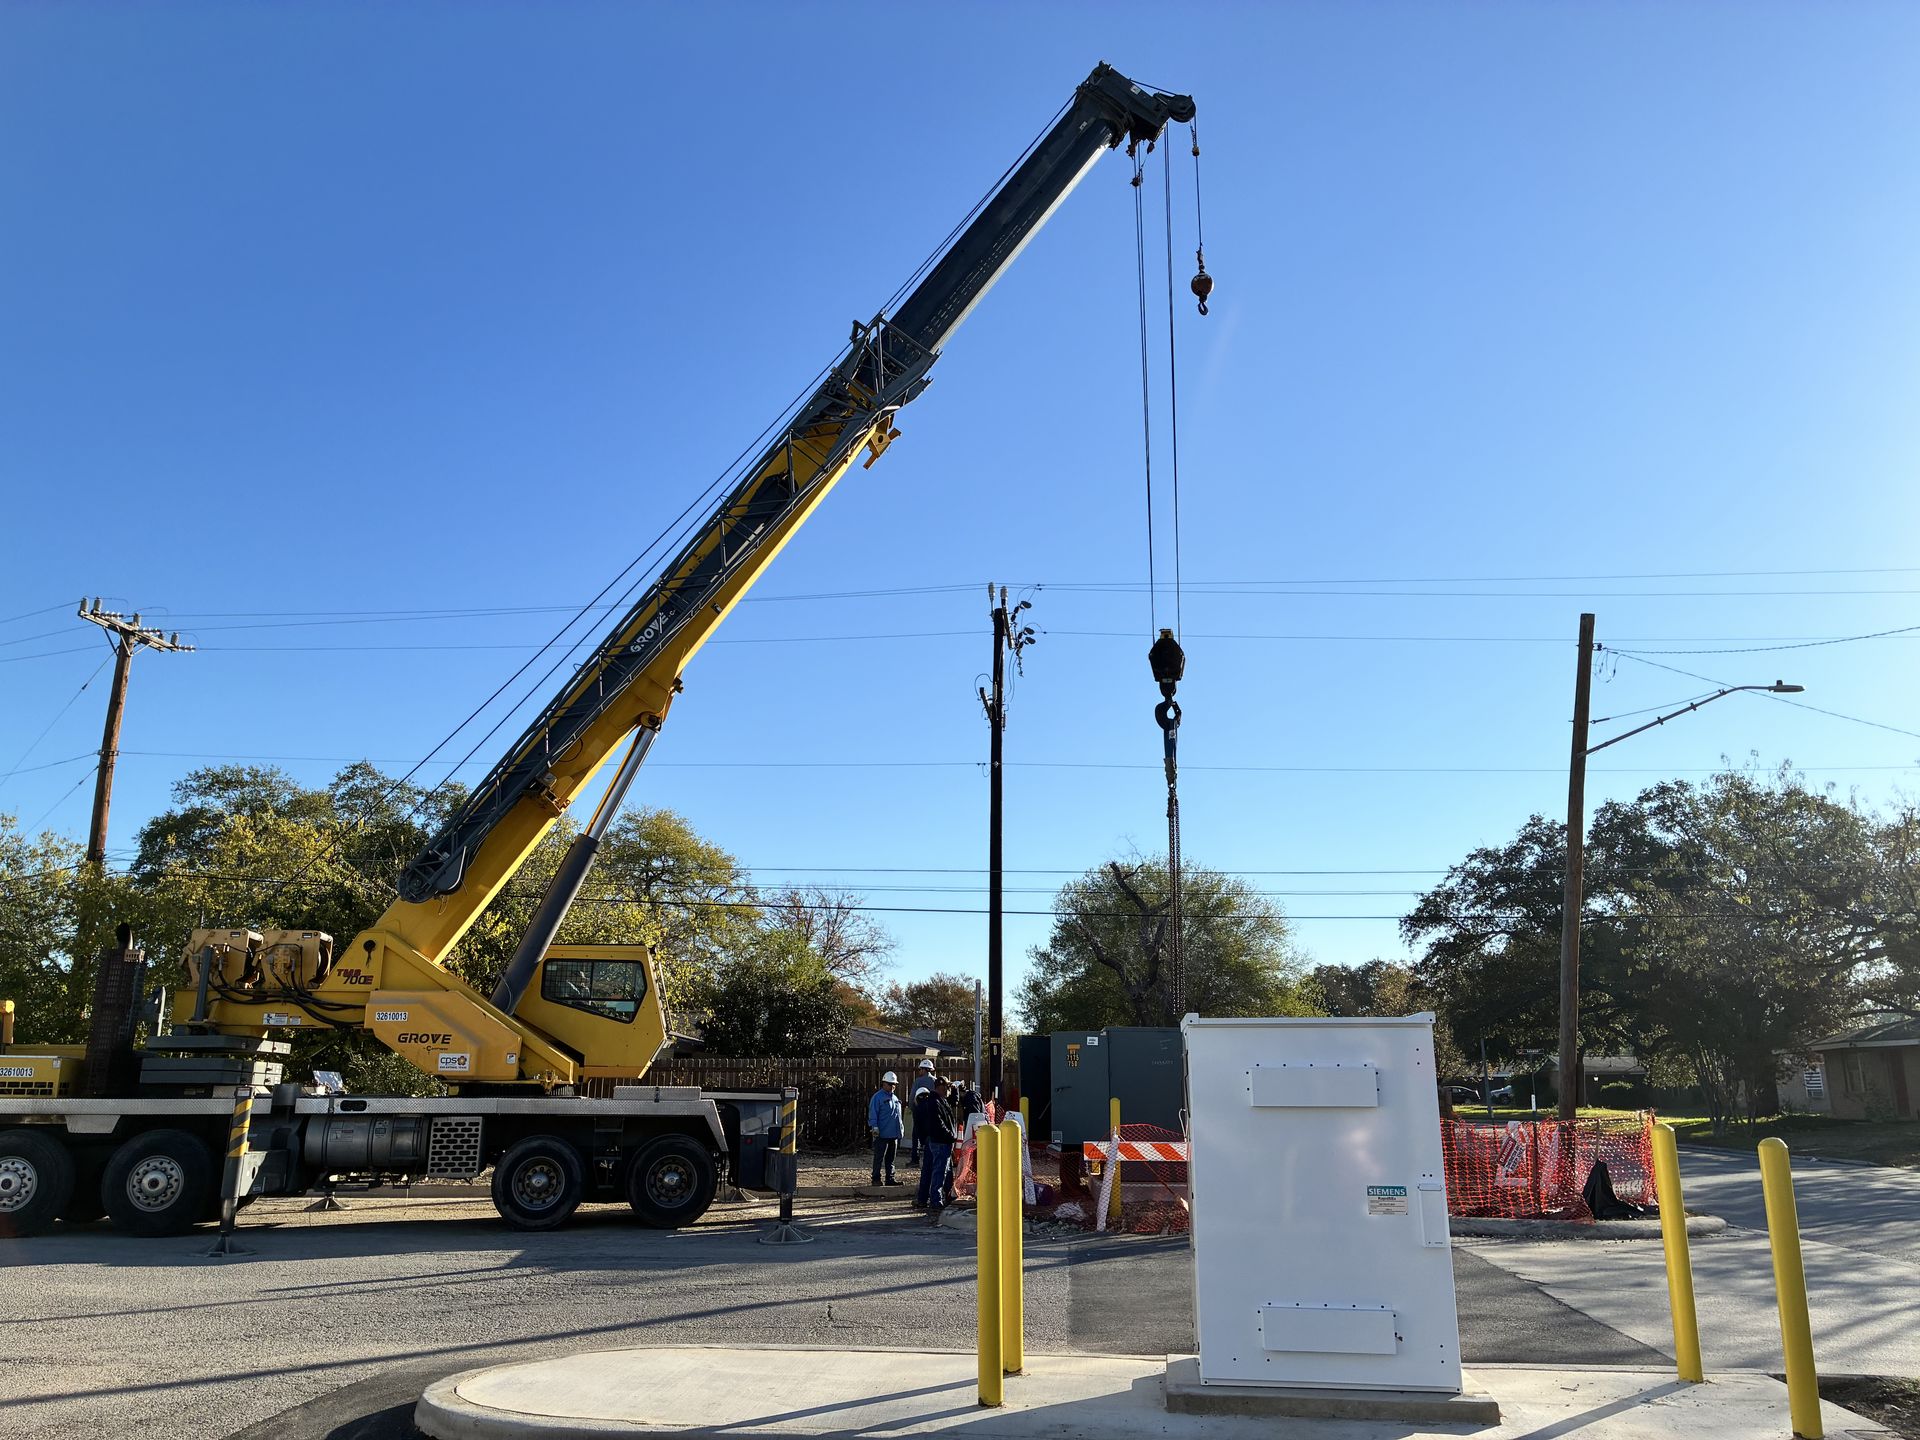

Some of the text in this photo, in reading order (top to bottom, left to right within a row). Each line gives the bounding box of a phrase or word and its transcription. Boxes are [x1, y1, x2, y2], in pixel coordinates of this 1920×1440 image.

[630, 611, 669, 653] GROVE
[343, 975, 374, 985] 700E
[376, 1012, 407, 1021] 32610013
[398, 1033, 452, 1044] GROVE
[440, 1056, 457, 1066] cps
[0, 1067, 34, 1077] 32610013
[1368, 1188, 1406, 1196] SIEMENS
